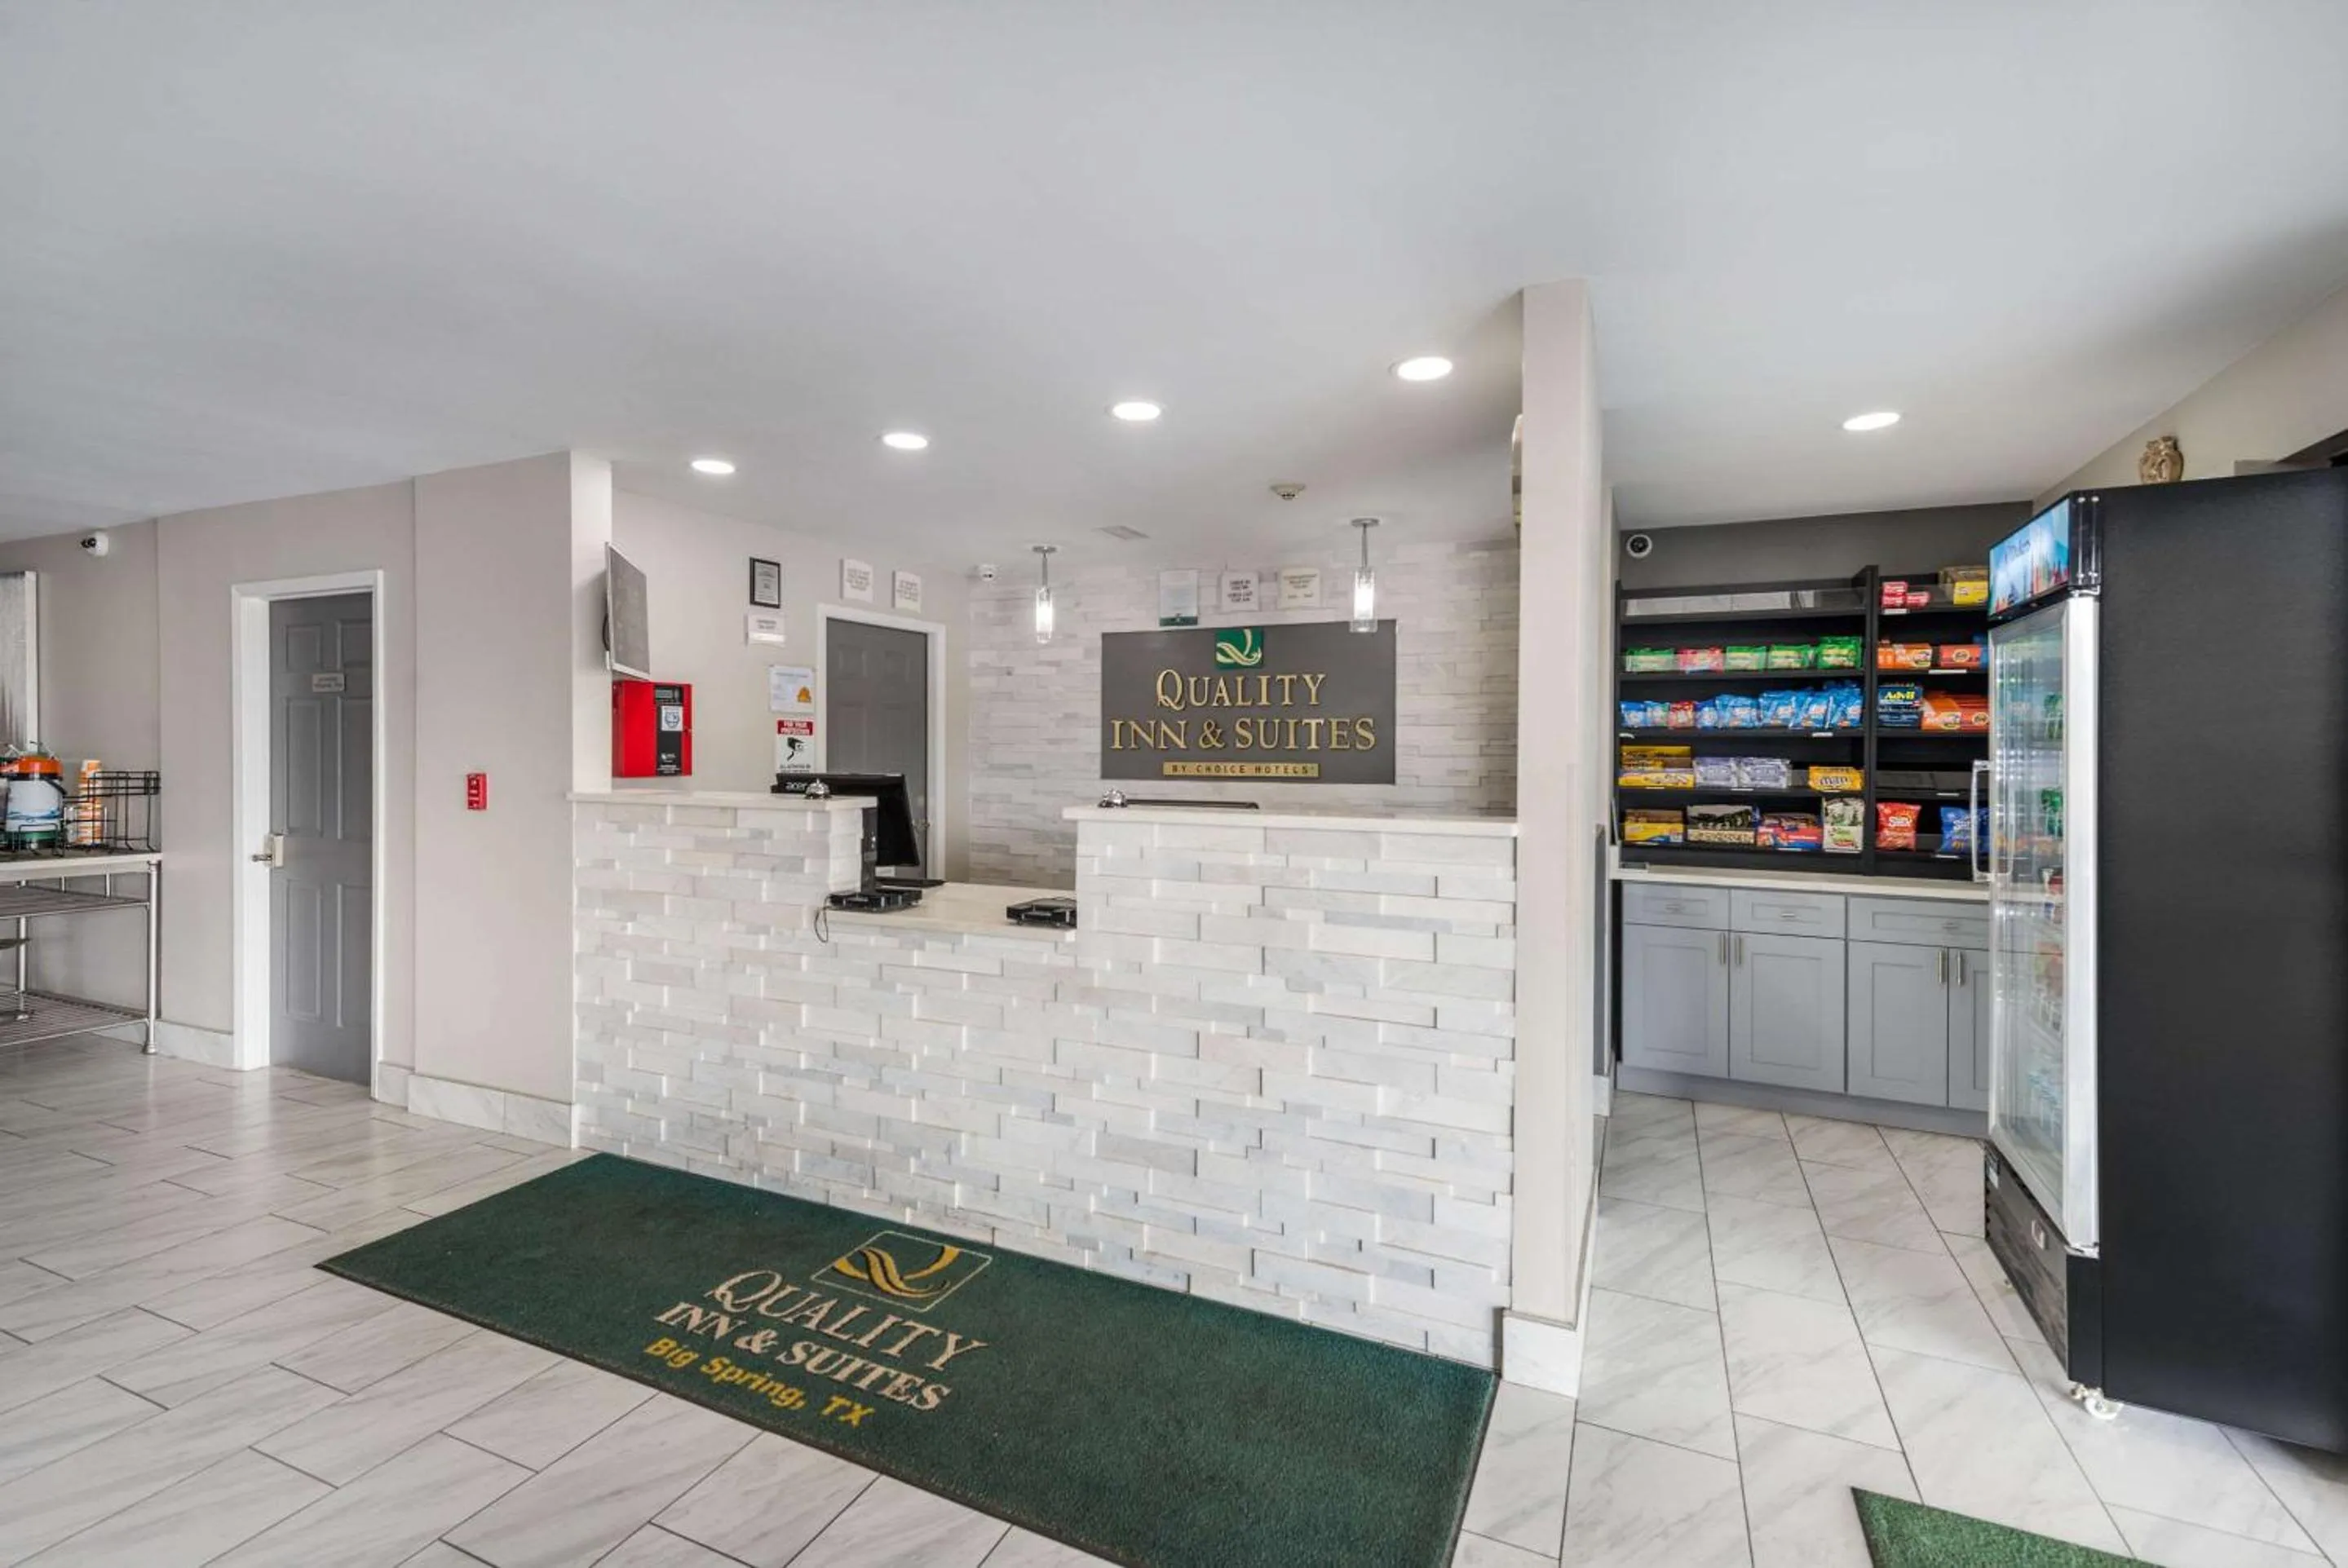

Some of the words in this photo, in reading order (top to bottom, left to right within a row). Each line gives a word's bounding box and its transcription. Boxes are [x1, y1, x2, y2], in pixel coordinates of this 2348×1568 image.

[1156, 669, 1327, 711] QUALITY
[1110, 719, 1188, 749] INN
[1198, 718, 1227, 749] &
[1234, 717, 1377, 750] SUITES
[1196, 764, 1247, 775] CHOICE
[703, 1269, 988, 1371] QUALITY
[643, 1336, 701, 1369] Big
[700, 1356, 807, 1410] Spring,
[820, 1394, 876, 1427] TX
[654, 1301, 748, 1341] INN
[734, 1328, 780, 1354] &
[776, 1340, 952, 1410] SUITES
